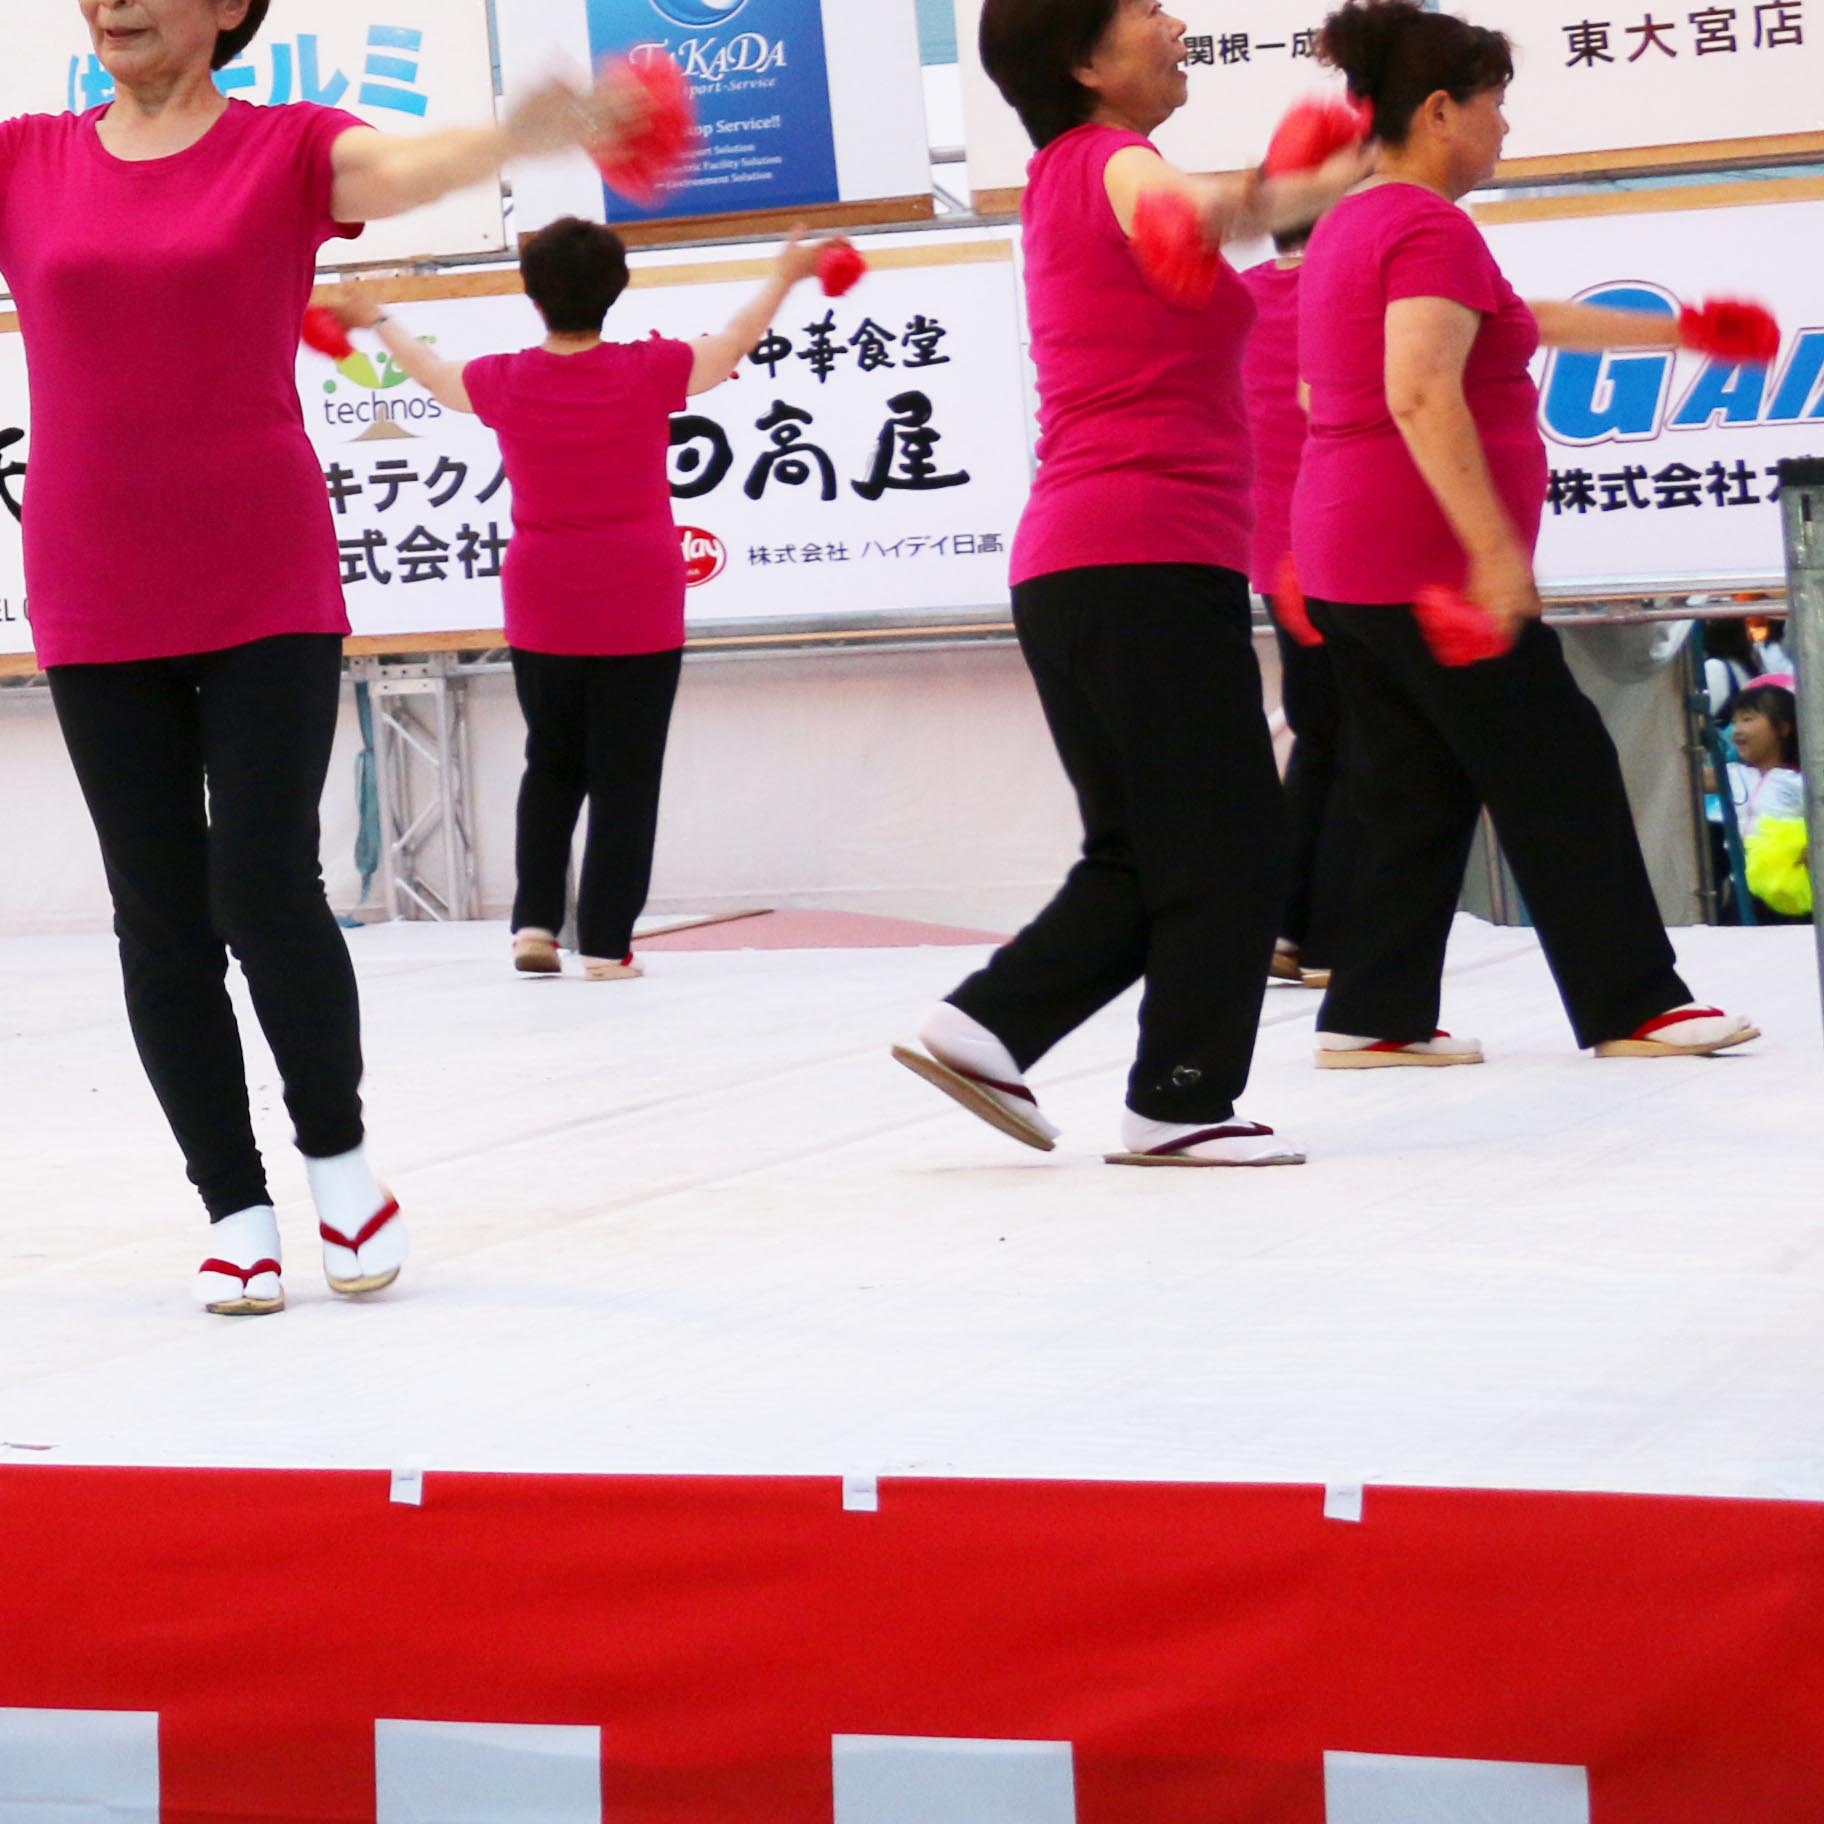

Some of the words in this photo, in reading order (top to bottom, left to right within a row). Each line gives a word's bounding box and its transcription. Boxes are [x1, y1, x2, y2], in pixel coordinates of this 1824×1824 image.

[1562, 0, 1804, 68] 東大宮店
[748, 309, 951, 384] 中華食堂
[324, 395, 442, 426] technos
[749, 542, 850, 566] 株式会社
